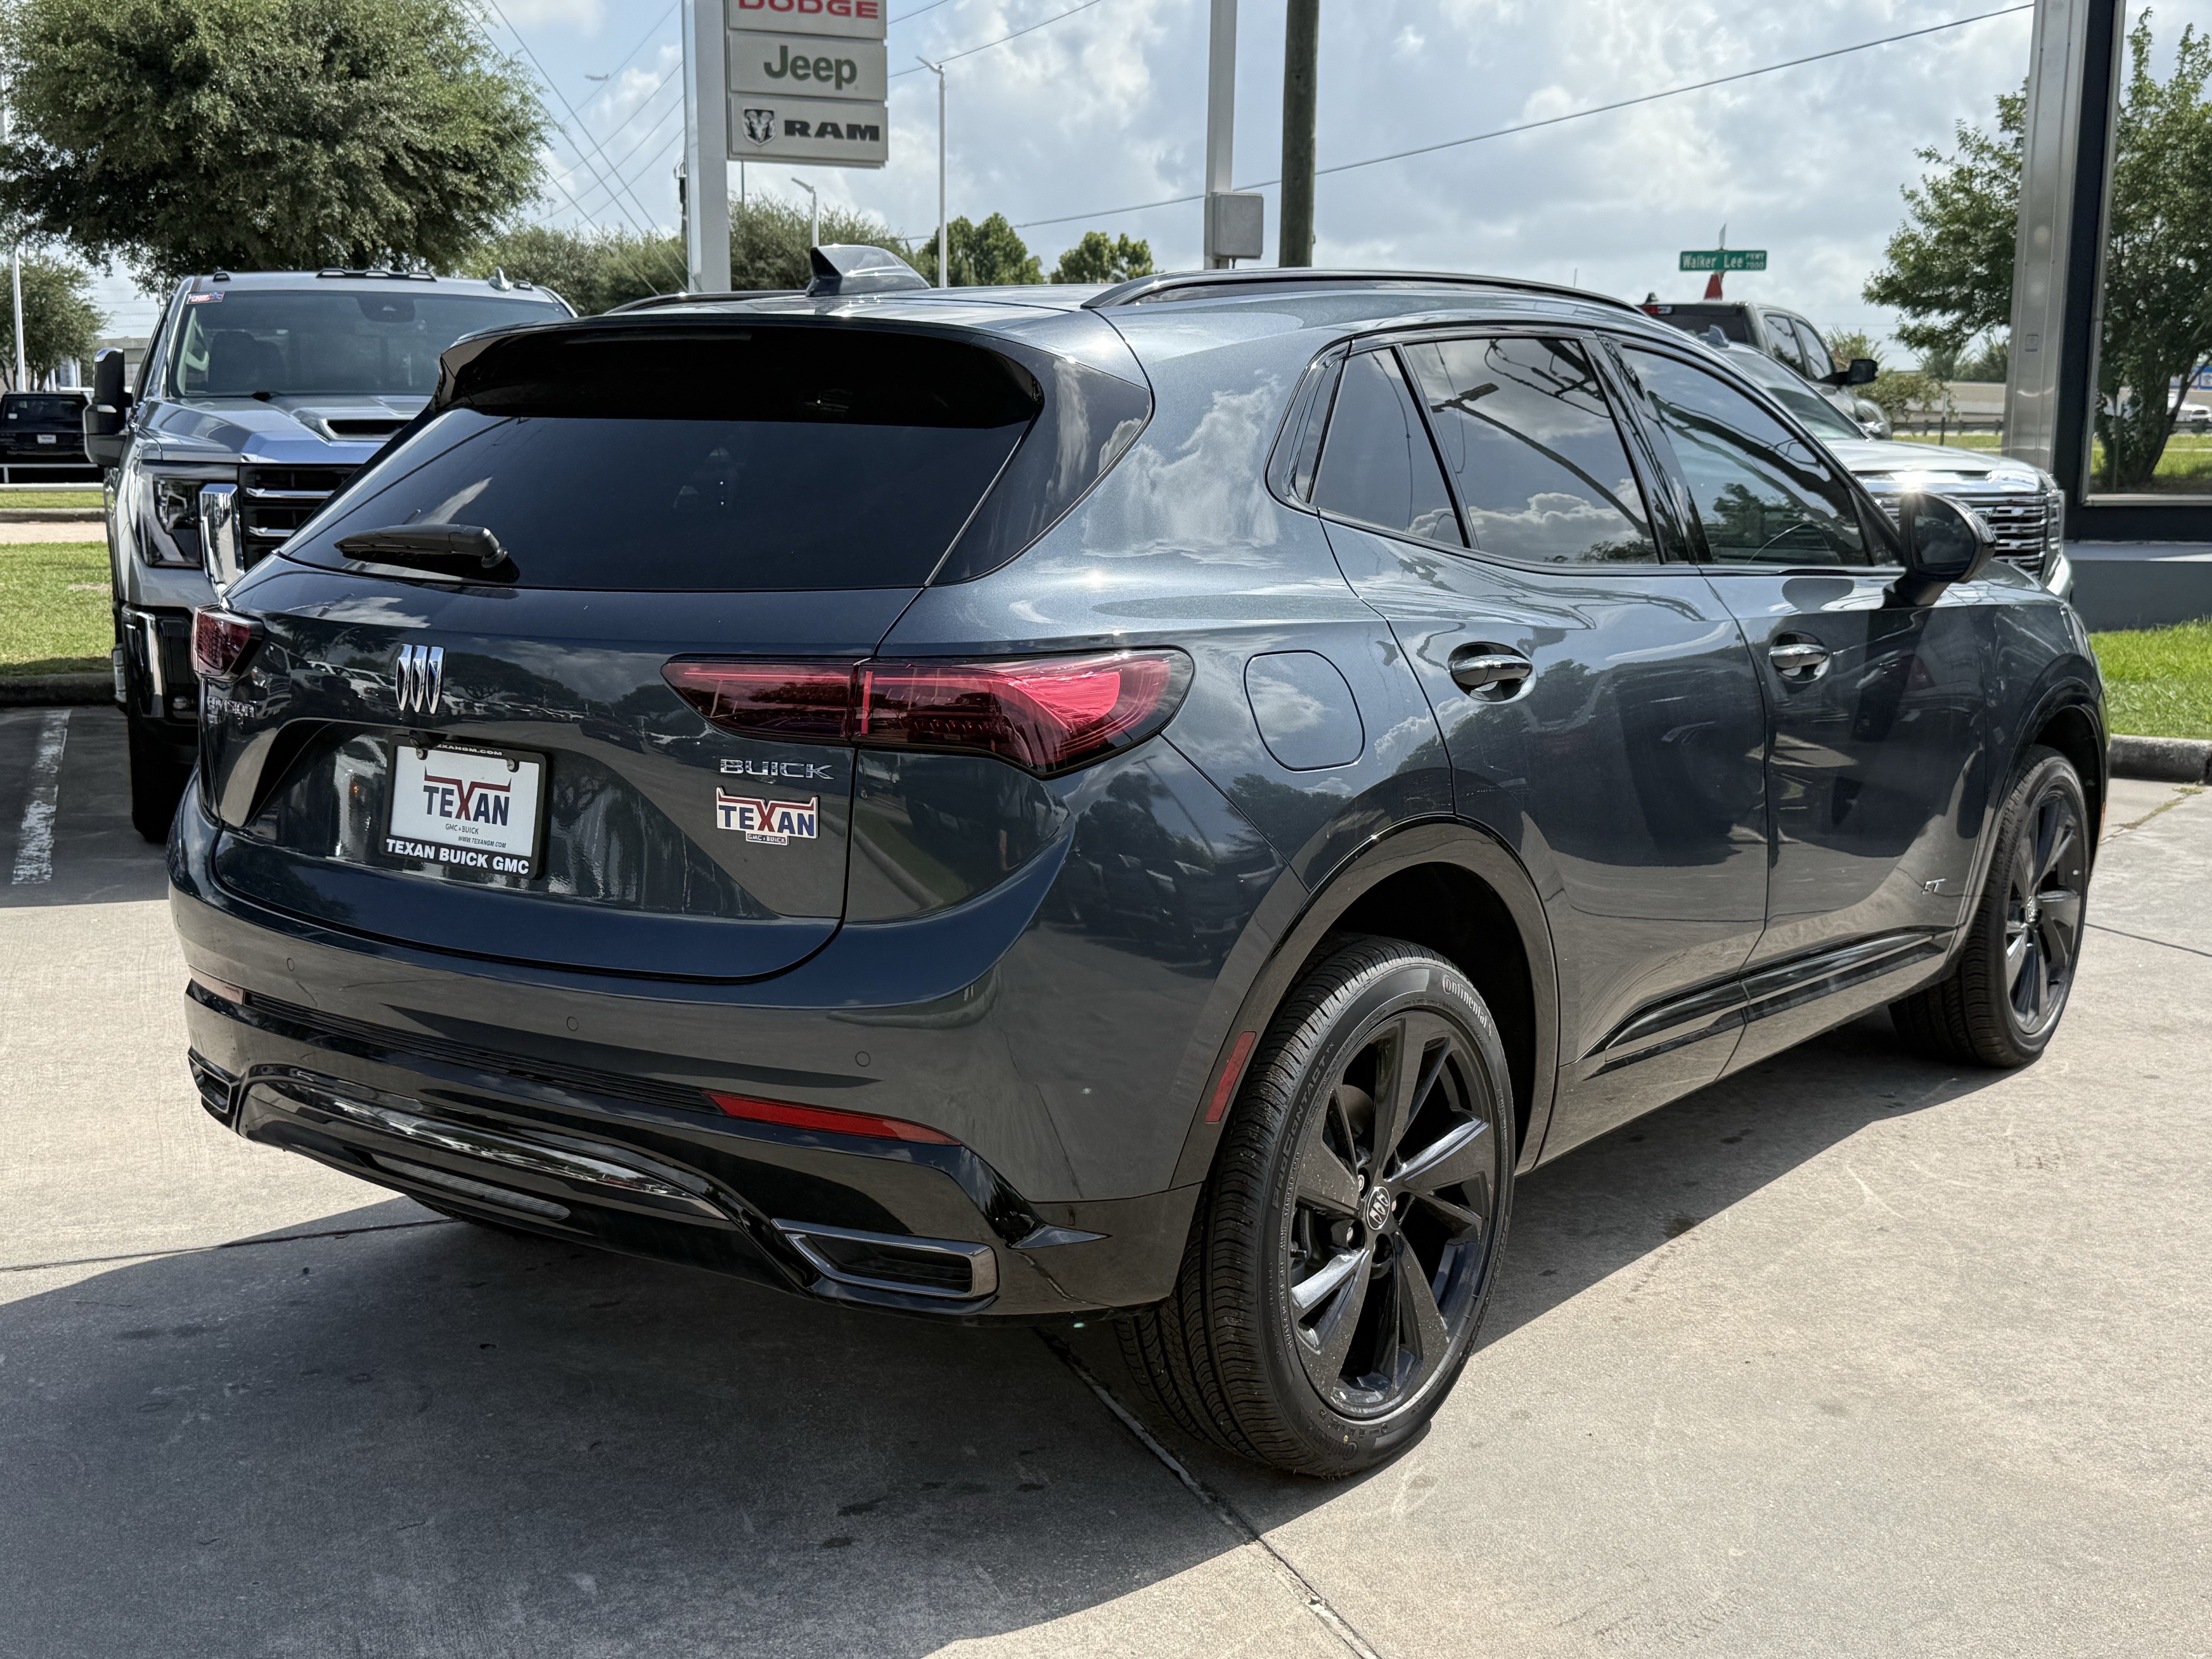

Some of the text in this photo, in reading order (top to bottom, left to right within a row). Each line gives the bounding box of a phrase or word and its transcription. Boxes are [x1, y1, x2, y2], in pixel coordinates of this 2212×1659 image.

[739, 0, 878, 19] DODGE
[764, 45, 857, 90] Jeep
[785, 120, 879, 141] RAM
[1683, 254, 1716, 268] Walker
[1724, 254, 1743, 268] Lee
[436, 744, 502, 756] XANGM.COM
[720, 759, 834, 779] BUICK
[423, 774, 511, 826] TEXAN
[718, 795, 814, 836] TEXAN
[462, 826, 479, 835] BUICK
[386, 838, 529, 874] TEXAN BUICK GMC
[1922, 878, 1946, 895] ST
[1443, 974, 1487, 1028] Continental
